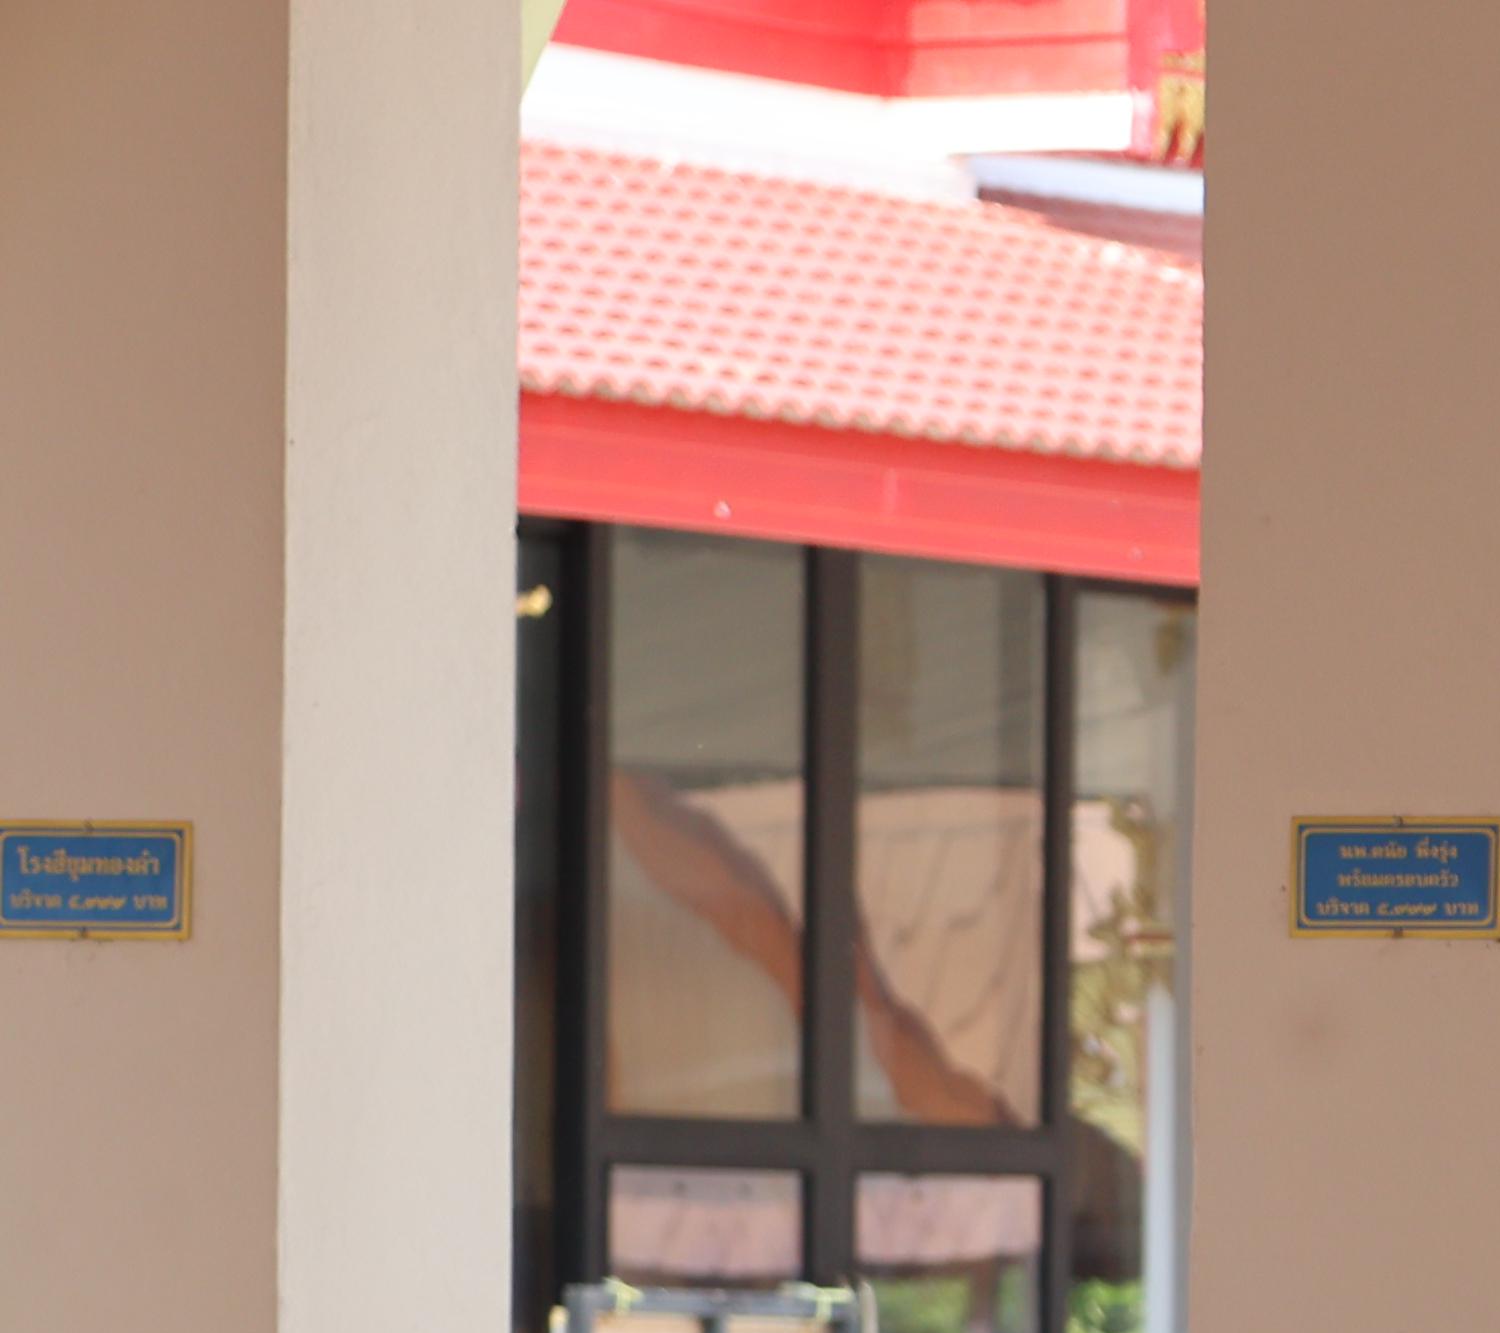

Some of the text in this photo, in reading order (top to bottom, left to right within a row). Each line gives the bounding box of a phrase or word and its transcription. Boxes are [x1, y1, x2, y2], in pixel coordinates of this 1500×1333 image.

[10, 888, 63, 909] บริจาค
[134, 894, 168, 909] บาท
[1316, 897, 1370, 915] บริจาค
[1444, 902, 1479, 915] บาท
